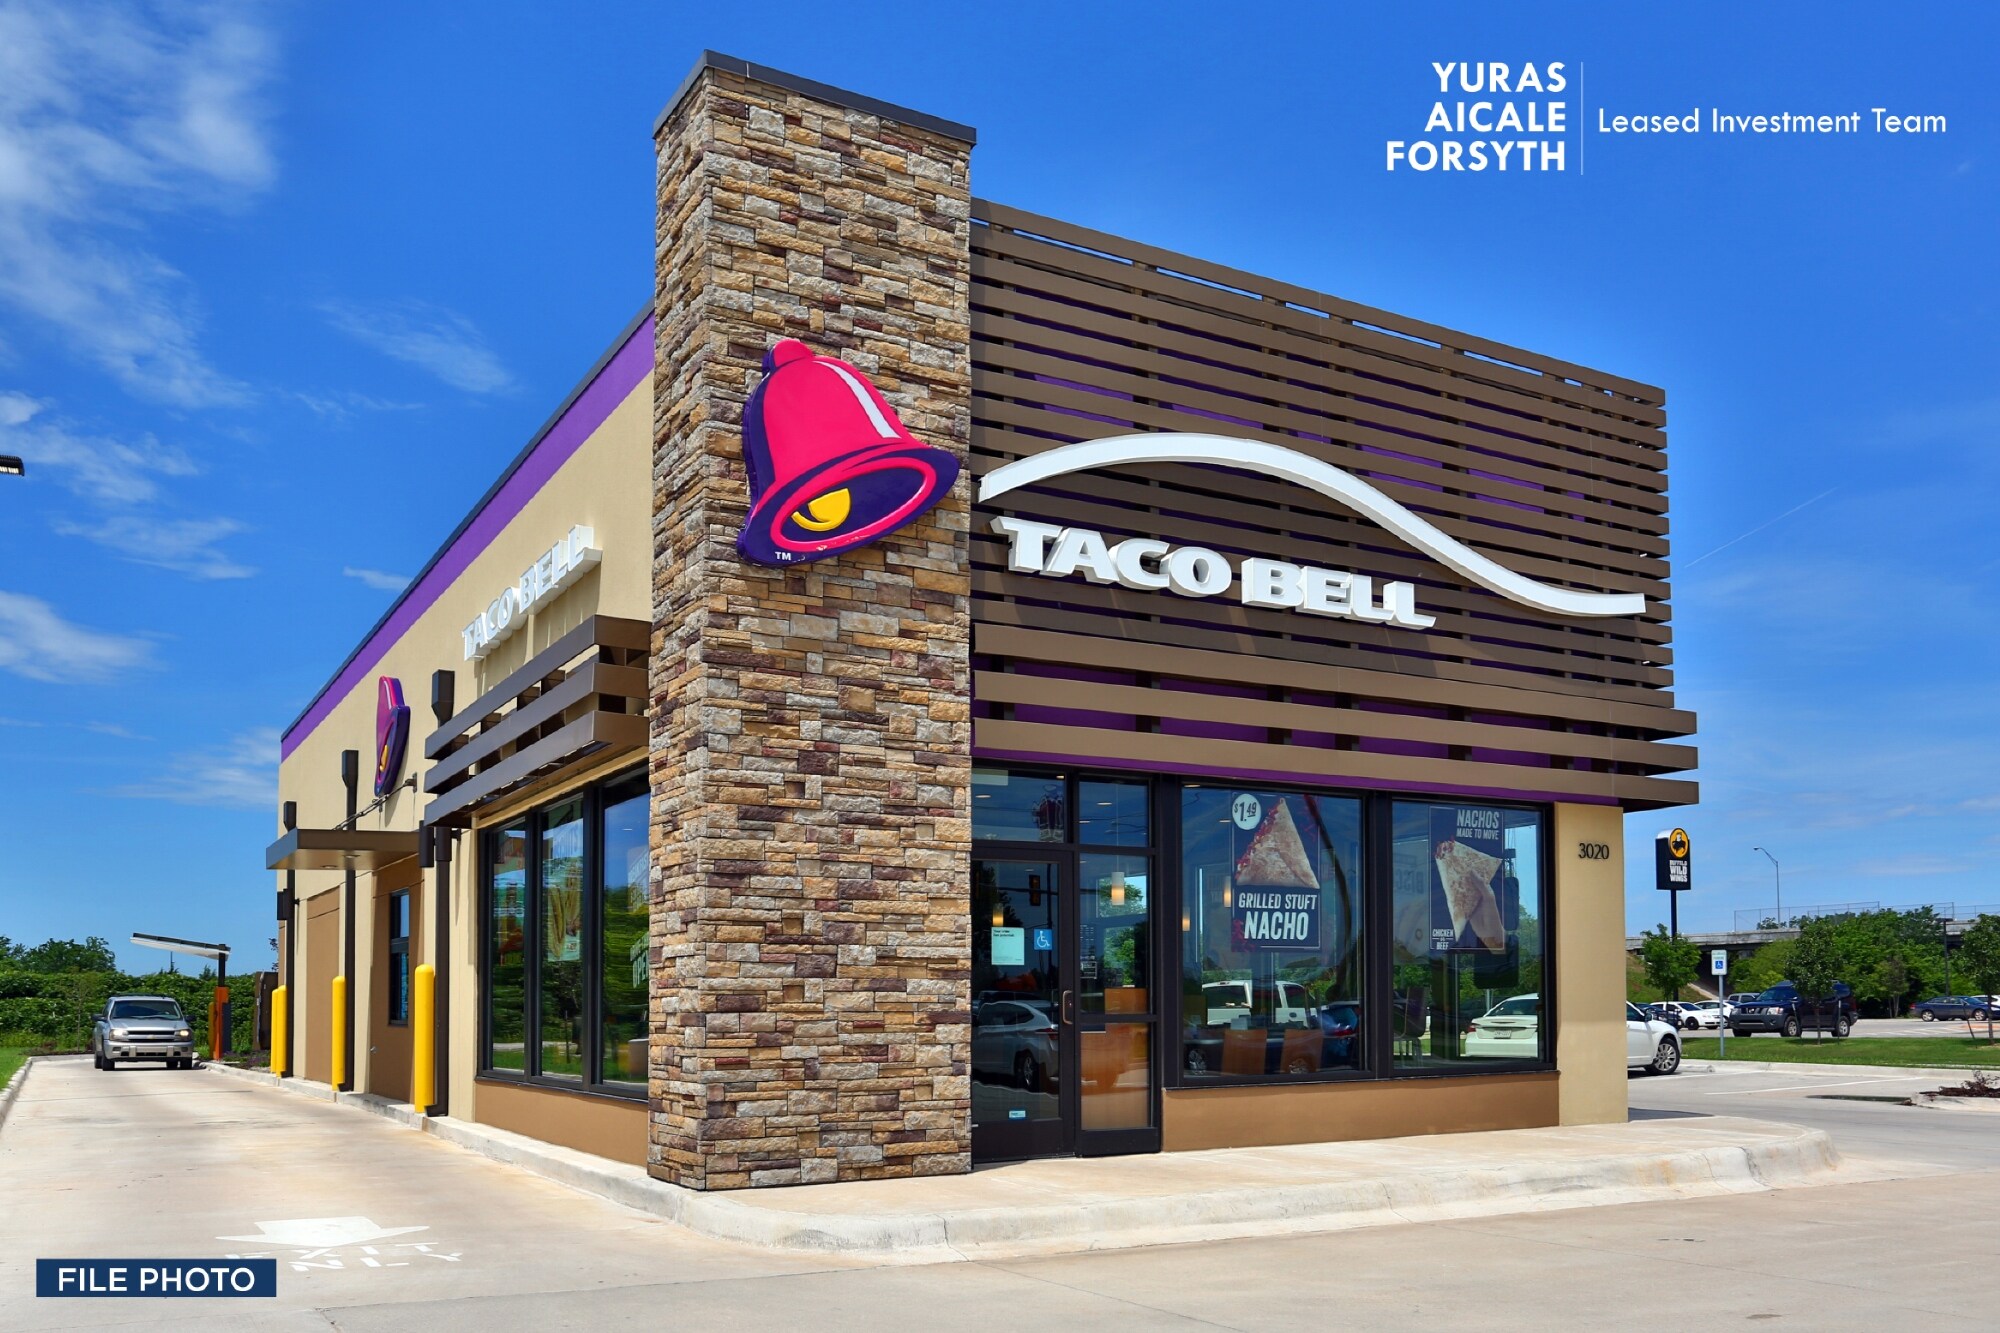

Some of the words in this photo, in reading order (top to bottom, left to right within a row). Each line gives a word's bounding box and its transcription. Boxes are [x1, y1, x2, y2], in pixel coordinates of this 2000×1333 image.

[774, 551, 792, 561] TM
[990, 515, 1232, 597] TACO
[1240, 556, 1437, 630] BELL
[462, 587, 519, 661] TACO
[519, 524, 601, 614] BELL
[1233, 801, 1258, 822] $1.49
[1456, 809, 1500, 829] NACHOS
[1456, 828, 1473, 838] MADE
[1474, 829, 1481, 839] TO
[1483, 829, 1499, 840] MOVE
[1578, 842, 1610, 860] 3020
[1670, 866, 1688, 875] WILD
[1670, 874, 1688, 883] WINGS
[1238, 892, 1281, 909] GRILLED
[1284, 894, 1318, 910] STUFT
[1243, 910, 1309, 941] NACHO
[1432, 928, 1454, 938] CHICKEN
[1436, 942, 1449, 950] BEEF
